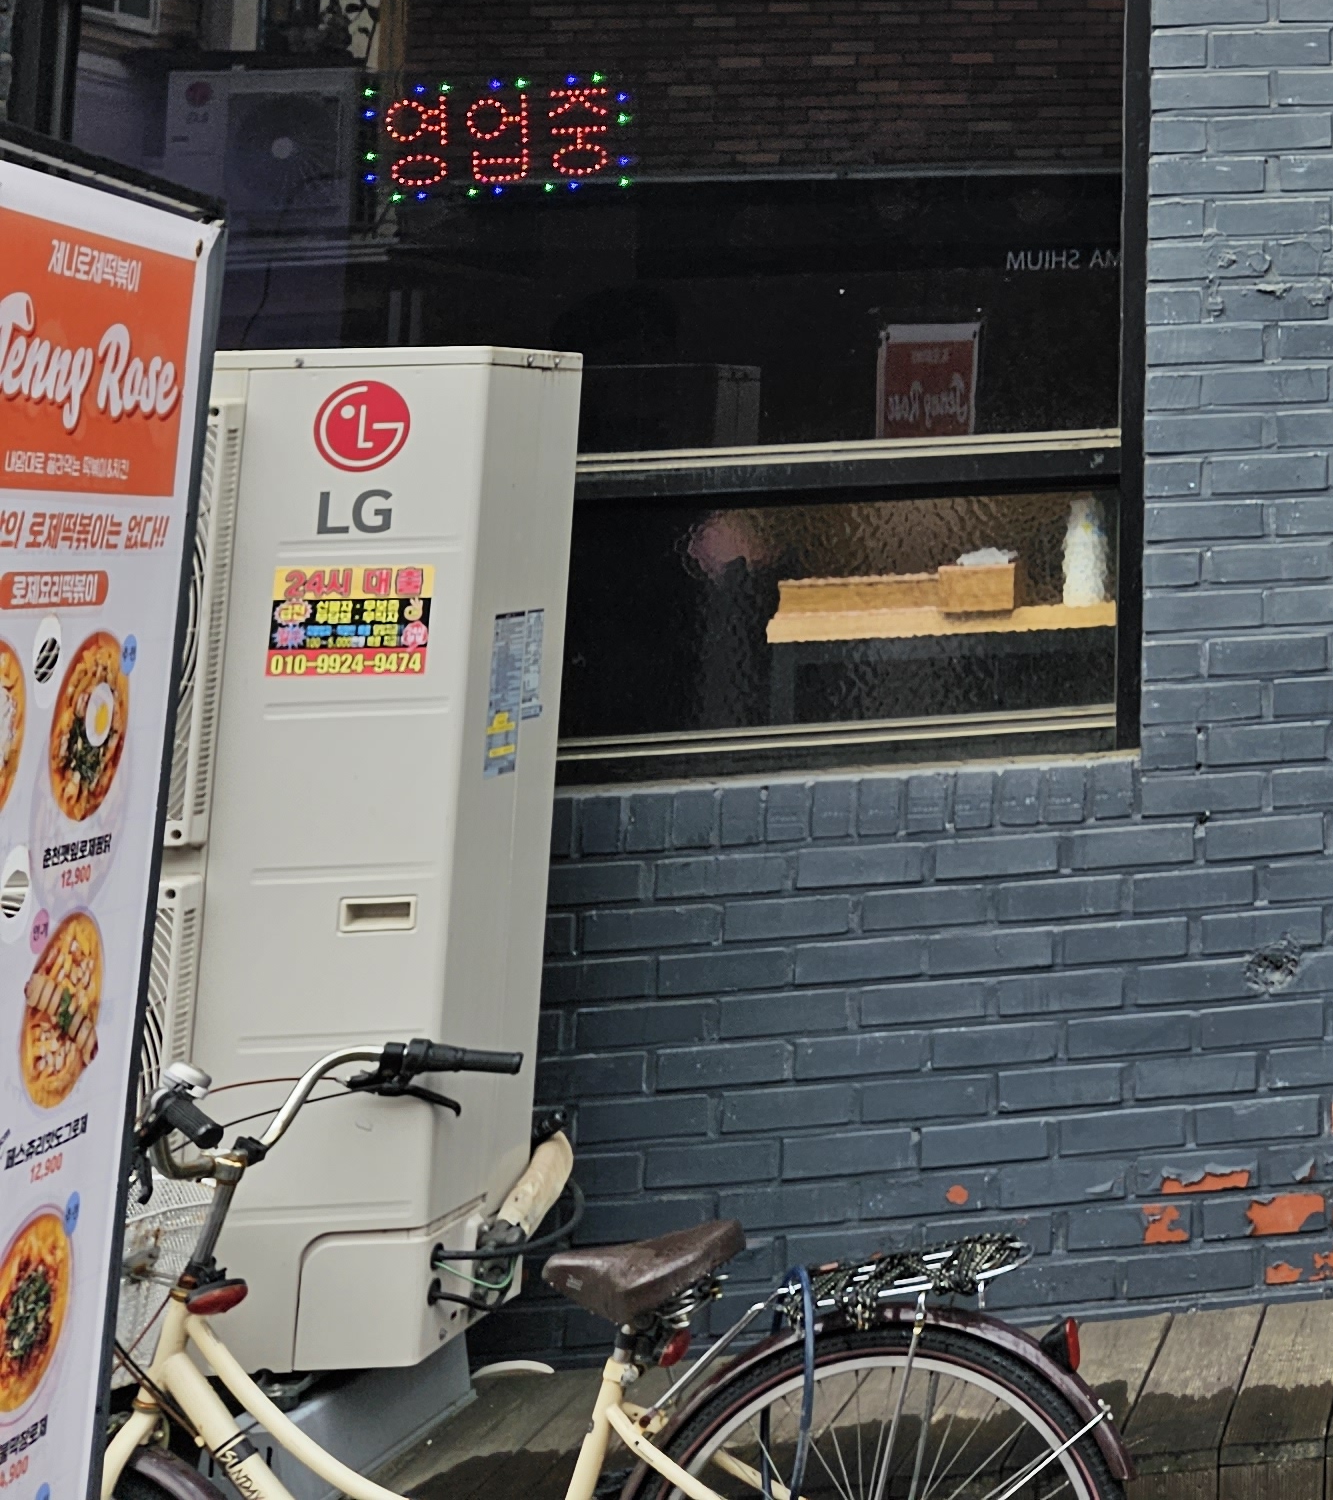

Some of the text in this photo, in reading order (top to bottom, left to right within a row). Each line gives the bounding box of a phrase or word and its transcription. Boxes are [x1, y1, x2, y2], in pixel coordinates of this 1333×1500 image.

[385, 87, 607, 186] 영업중
[48, 239, 142, 292] 제니로제떡볶이
[96, 323, 181, 420] Rose
[0, 510, 170, 550] 의 로제떡볶이는 없다!!
[316, 489, 393, 535] LG
[10, 573, 99, 605] 로제요리떡볶이
[285, 568, 353, 599] 24시
[270, 651, 421, 675] 010-9924-9474
[60, 864, 92, 888] 12,900
[30, 1152, 63, 1184] 12,900
